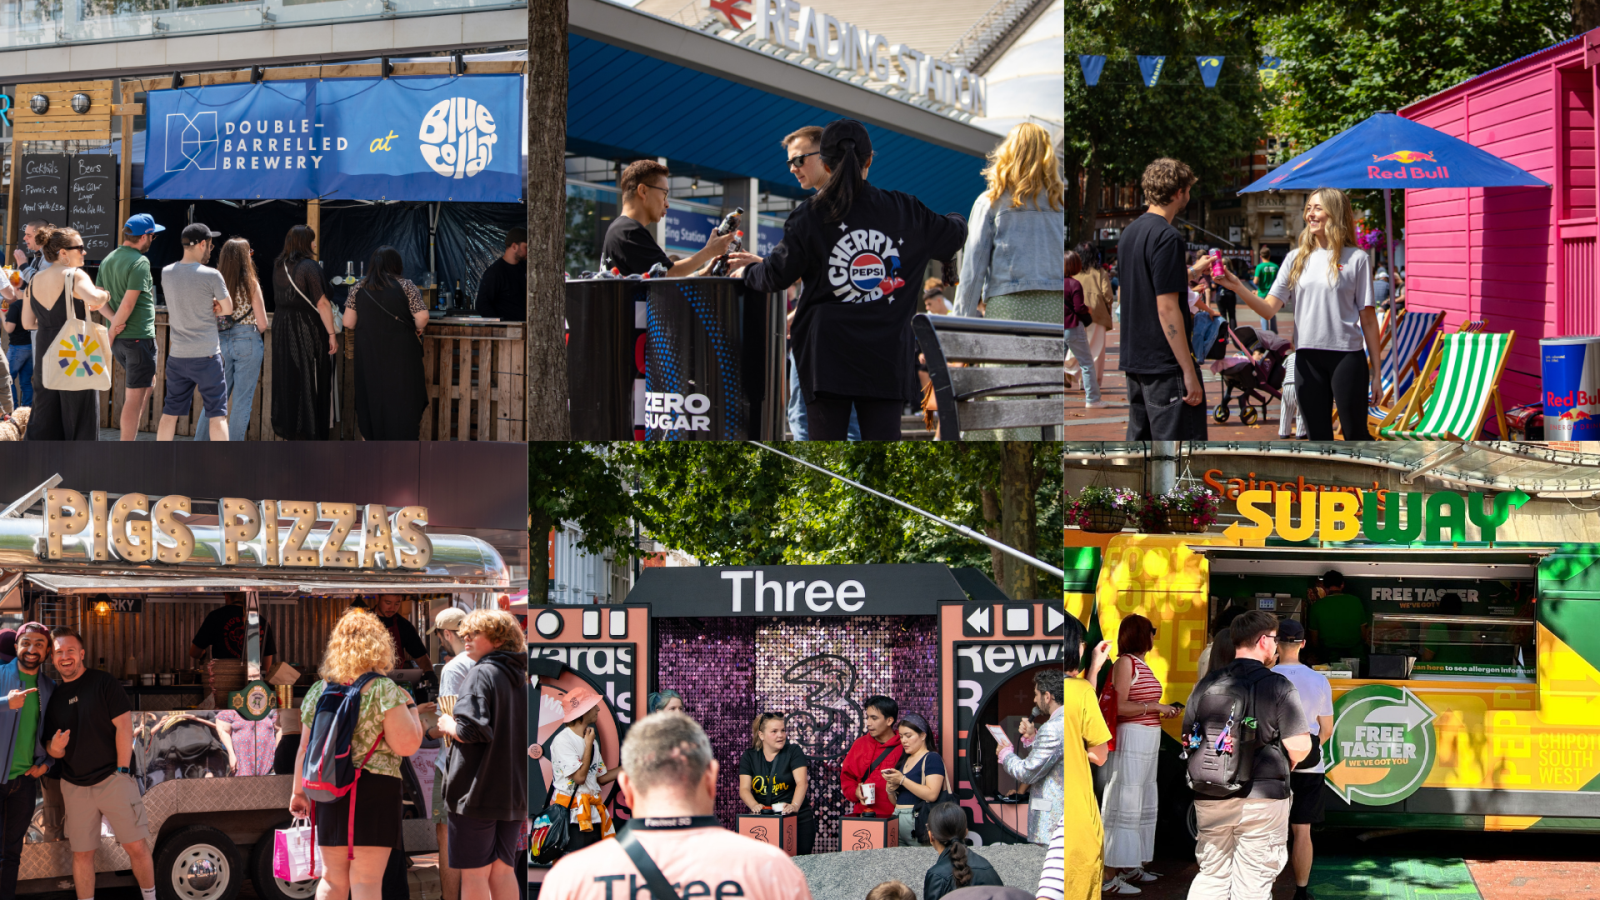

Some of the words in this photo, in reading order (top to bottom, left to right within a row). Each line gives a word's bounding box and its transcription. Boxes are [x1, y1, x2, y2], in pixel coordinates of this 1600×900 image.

[756, 0, 889, 82] READING
[891, 44, 987, 117] STATION
[419, 97, 496, 144] Blue
[223, 137, 348, 153] BARRELLED
[369, 130, 399, 153] at
[26, 160, 58, 175] Cocktails
[78, 159, 101, 175] Beers
[222, 155, 324, 170] BREWERY
[1367, 166, 1407, 179] Red
[1410, 166, 1450, 179] Bull
[1186, 242, 1209, 250] Three
[828, 229, 900, 287] CHERRY
[852, 268, 884, 277] PEPSI
[645, 391, 711, 414] ZERO
[1547, 390, 1574, 407] Red
[645, 413, 711, 431] SUGAR
[1222, 486, 1531, 543] SUBWAY
[42, 488, 196, 564] PIGS
[218, 497, 433, 570] PIZZAS
[720, 570, 866, 613] Three
[1371, 587, 1414, 601] FREE
[1426, 663, 1444, 671] here
[1468, 663, 1500, 674] allergen
[1355, 726, 1405, 742] FREE
[1340, 741, 1417, 759] TASTER
[1538, 749, 1593, 768] SOUTH
[1348, 759, 1374, 767] WE'VE
[1538, 767, 1582, 785] WEST
